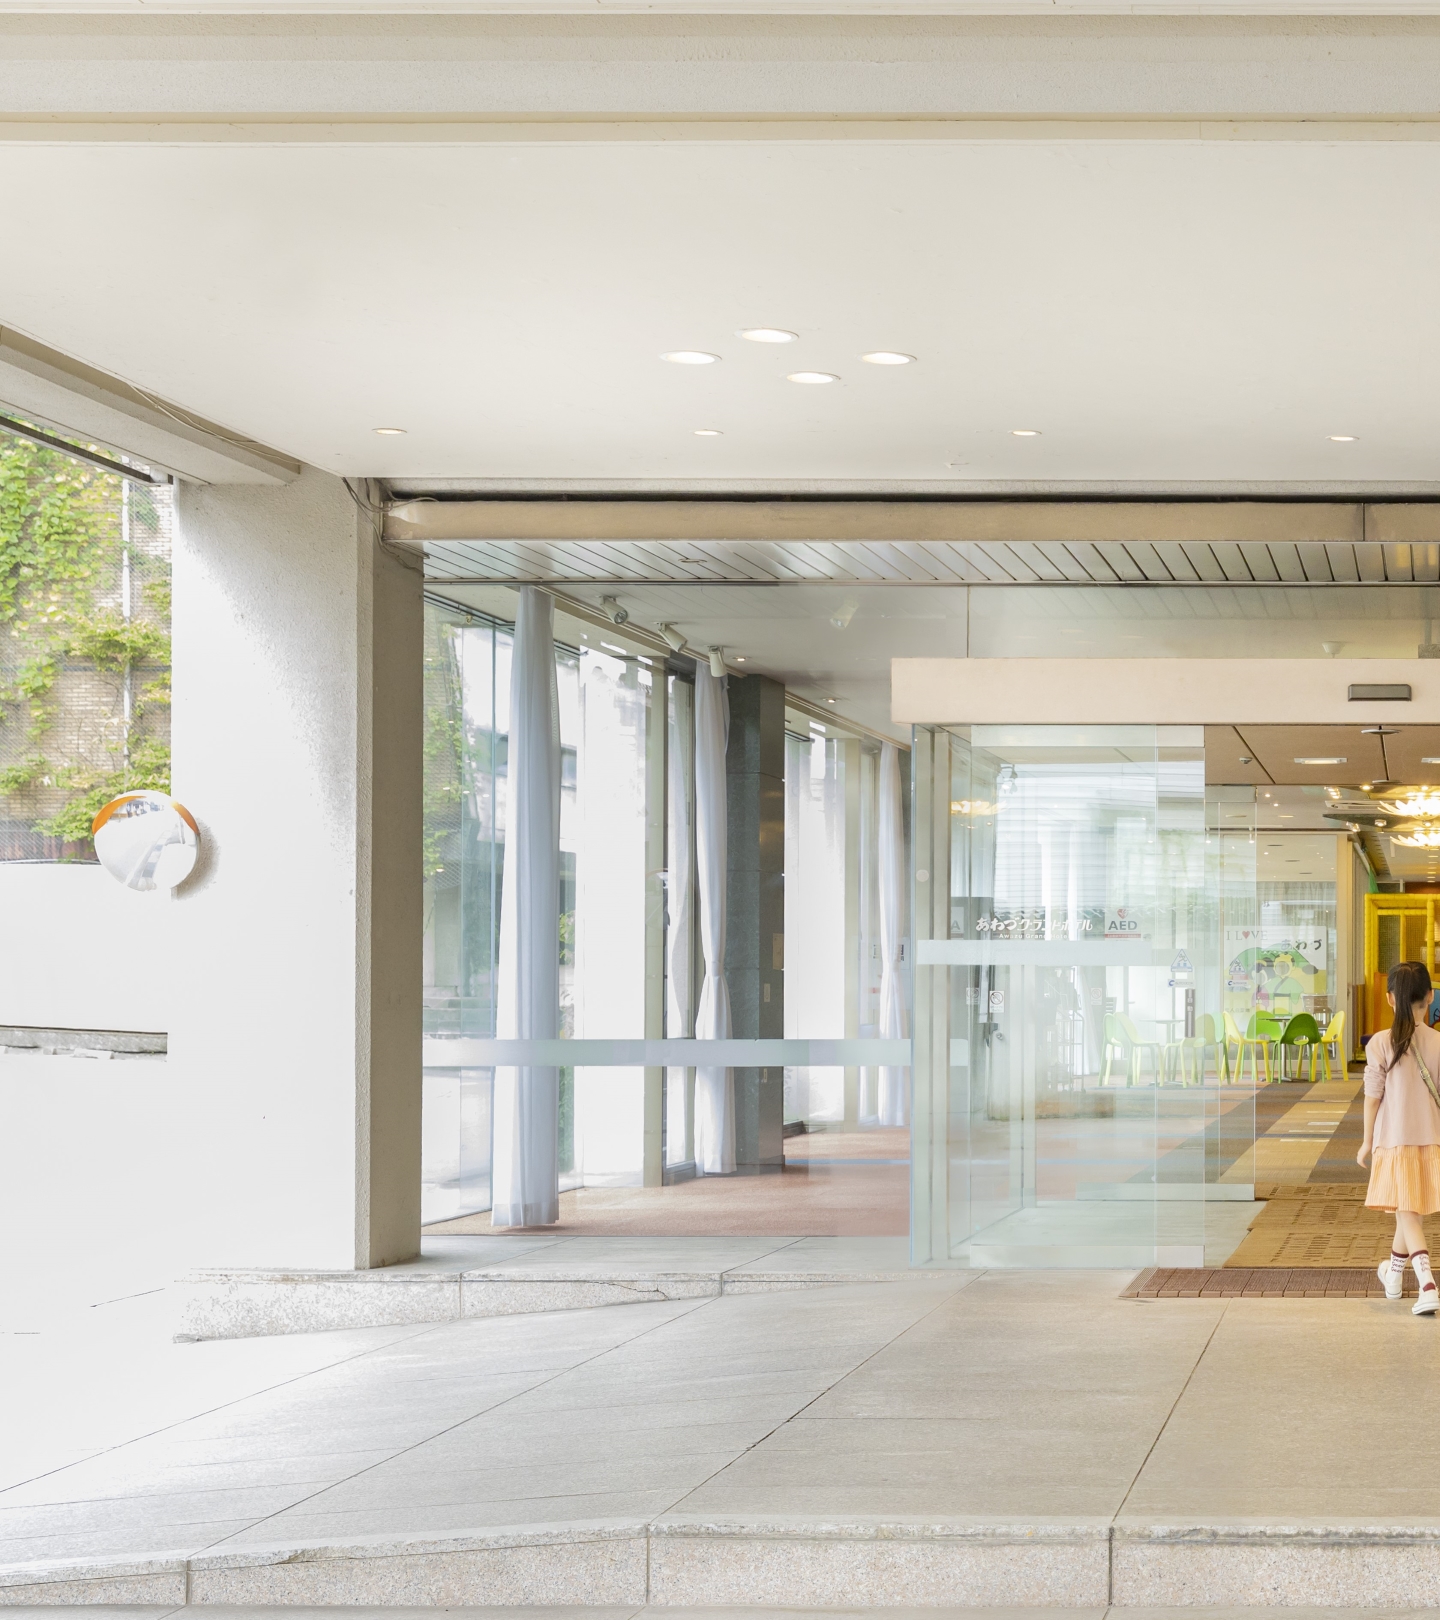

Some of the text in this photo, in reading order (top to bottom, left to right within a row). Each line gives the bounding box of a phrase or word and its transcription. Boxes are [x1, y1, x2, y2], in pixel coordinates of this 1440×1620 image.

[1108, 920, 1138, 931] AED
[1226, 930, 1231, 941] I
[1281, 938, 1323, 952] あわづ
